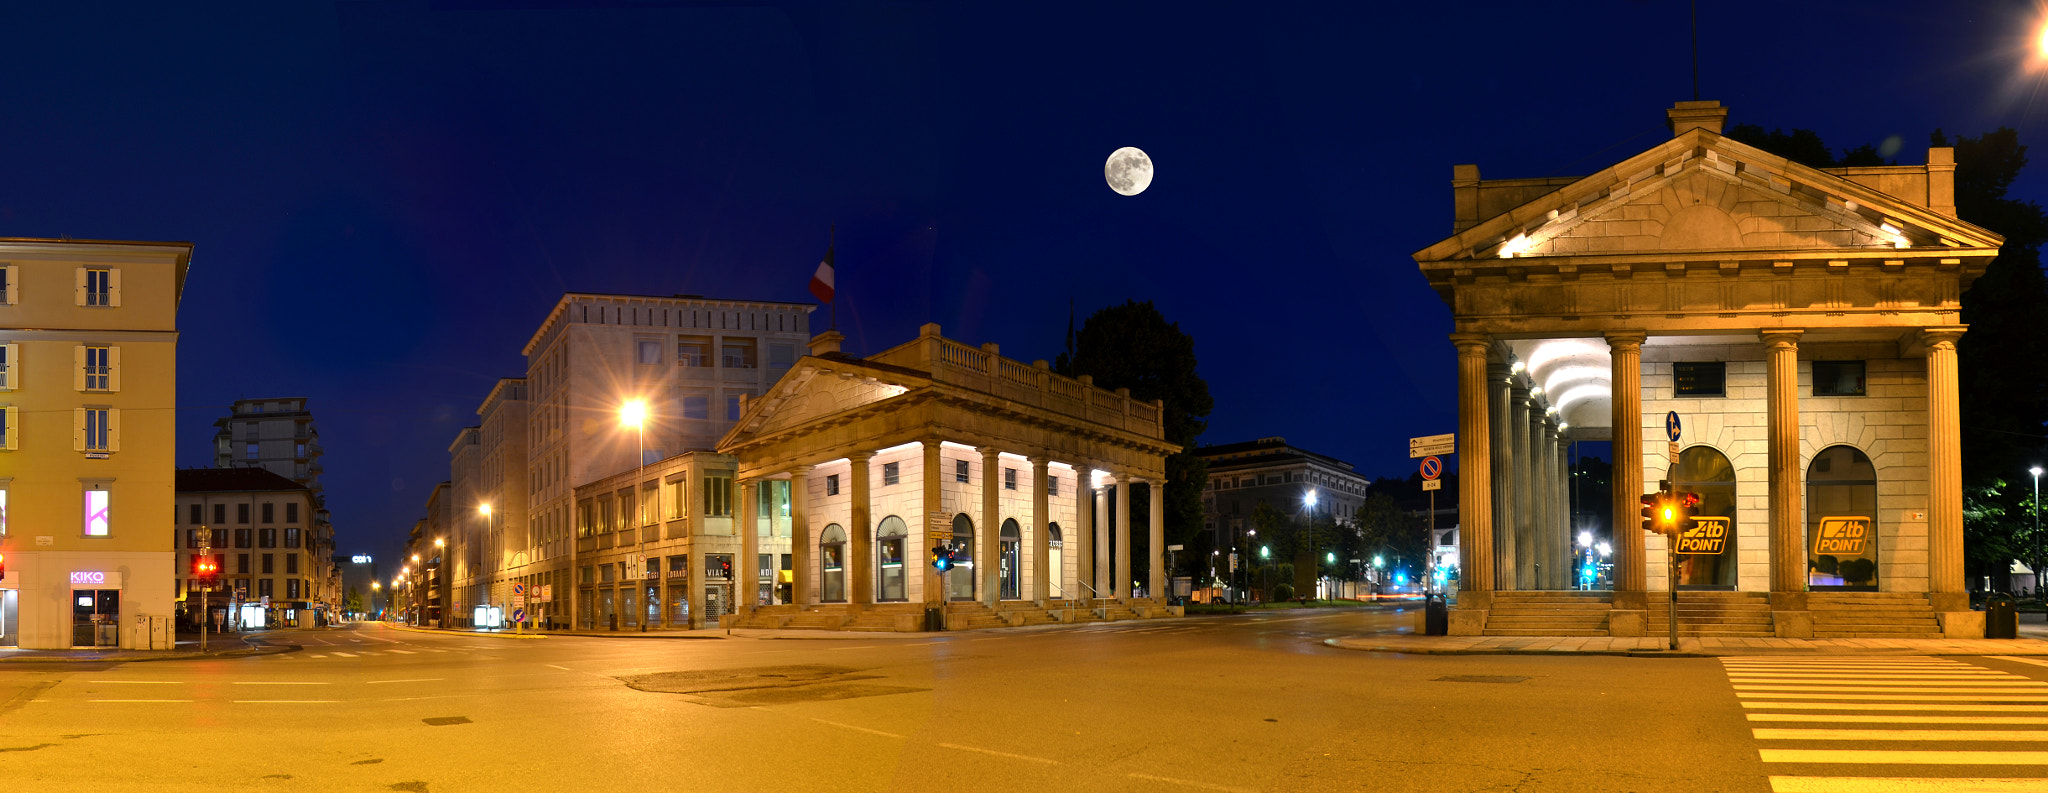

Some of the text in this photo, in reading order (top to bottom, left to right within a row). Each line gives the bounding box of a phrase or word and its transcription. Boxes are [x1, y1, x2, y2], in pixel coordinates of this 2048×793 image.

[1680, 538, 1722, 551] POINT
[1820, 539, 1862, 551] POINT
[71, 571, 104, 581] KIKO
